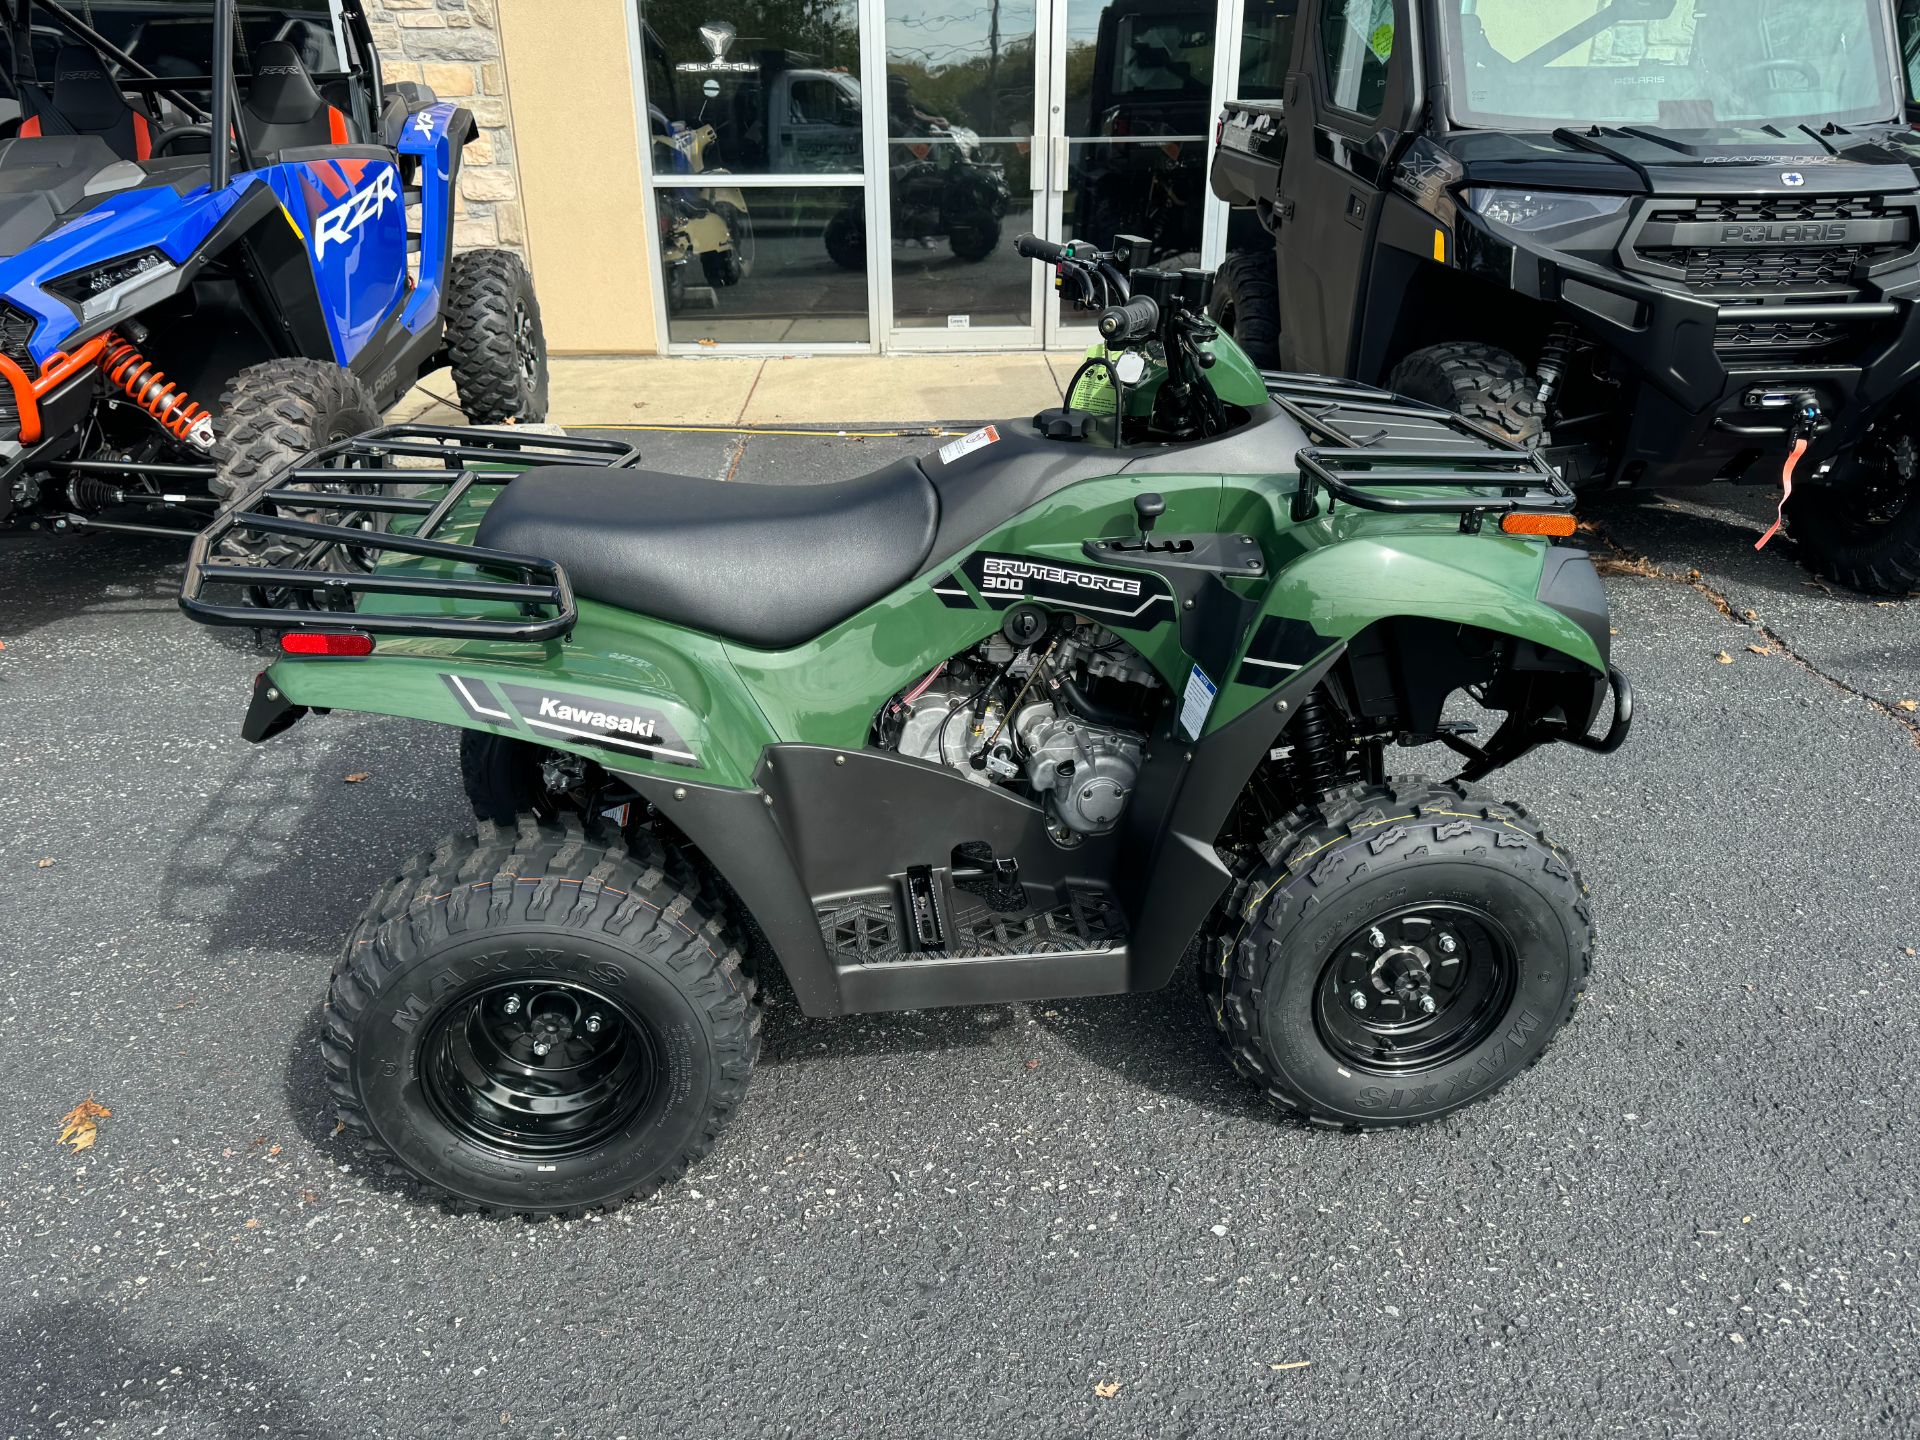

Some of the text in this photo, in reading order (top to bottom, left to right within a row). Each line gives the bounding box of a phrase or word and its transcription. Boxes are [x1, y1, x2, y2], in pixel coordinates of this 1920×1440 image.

[1614, 76, 1665, 85] POLARIS
[414, 111, 435, 141] XP
[1400, 151, 1454, 182] XP
[1401, 170, 1438, 198] 1000
[315, 165, 398, 262] RZR
[1720, 223, 1847, 244] POLARIS
[982, 575, 1024, 591] 300
[539, 697, 656, 738] Kawasaki
[392, 948, 628, 1034] MAXXIS
[1354, 1009, 1543, 1110] MAXXIS
